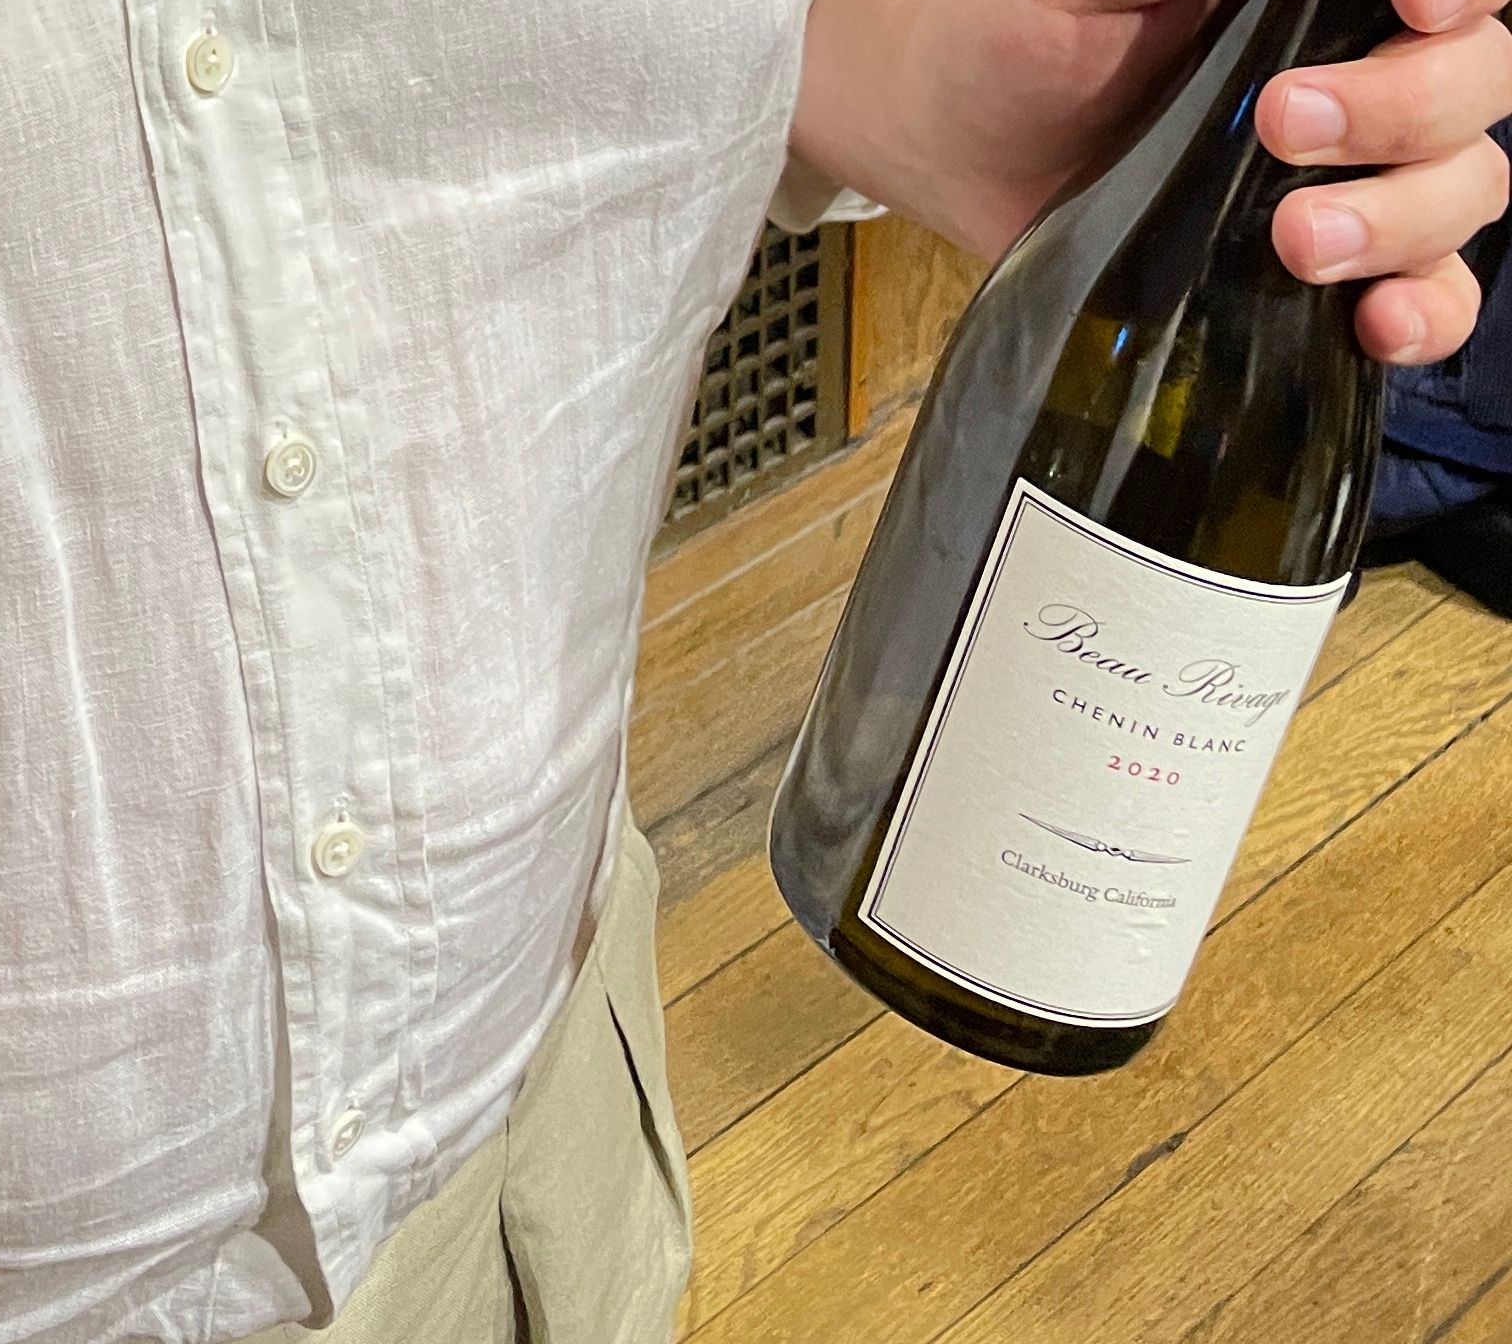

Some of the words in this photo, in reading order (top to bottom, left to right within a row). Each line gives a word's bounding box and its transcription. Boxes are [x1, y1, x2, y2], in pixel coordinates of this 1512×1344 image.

[1023, 603, 1152, 685] Beau
[1052, 688, 1160, 740] CHENIN
[1172, 732, 1247, 753] BLANC
[1106, 755, 1181, 786] 2020
[1000, 848, 1101, 903] Clarksburg
[1103, 886, 1177, 909] California
